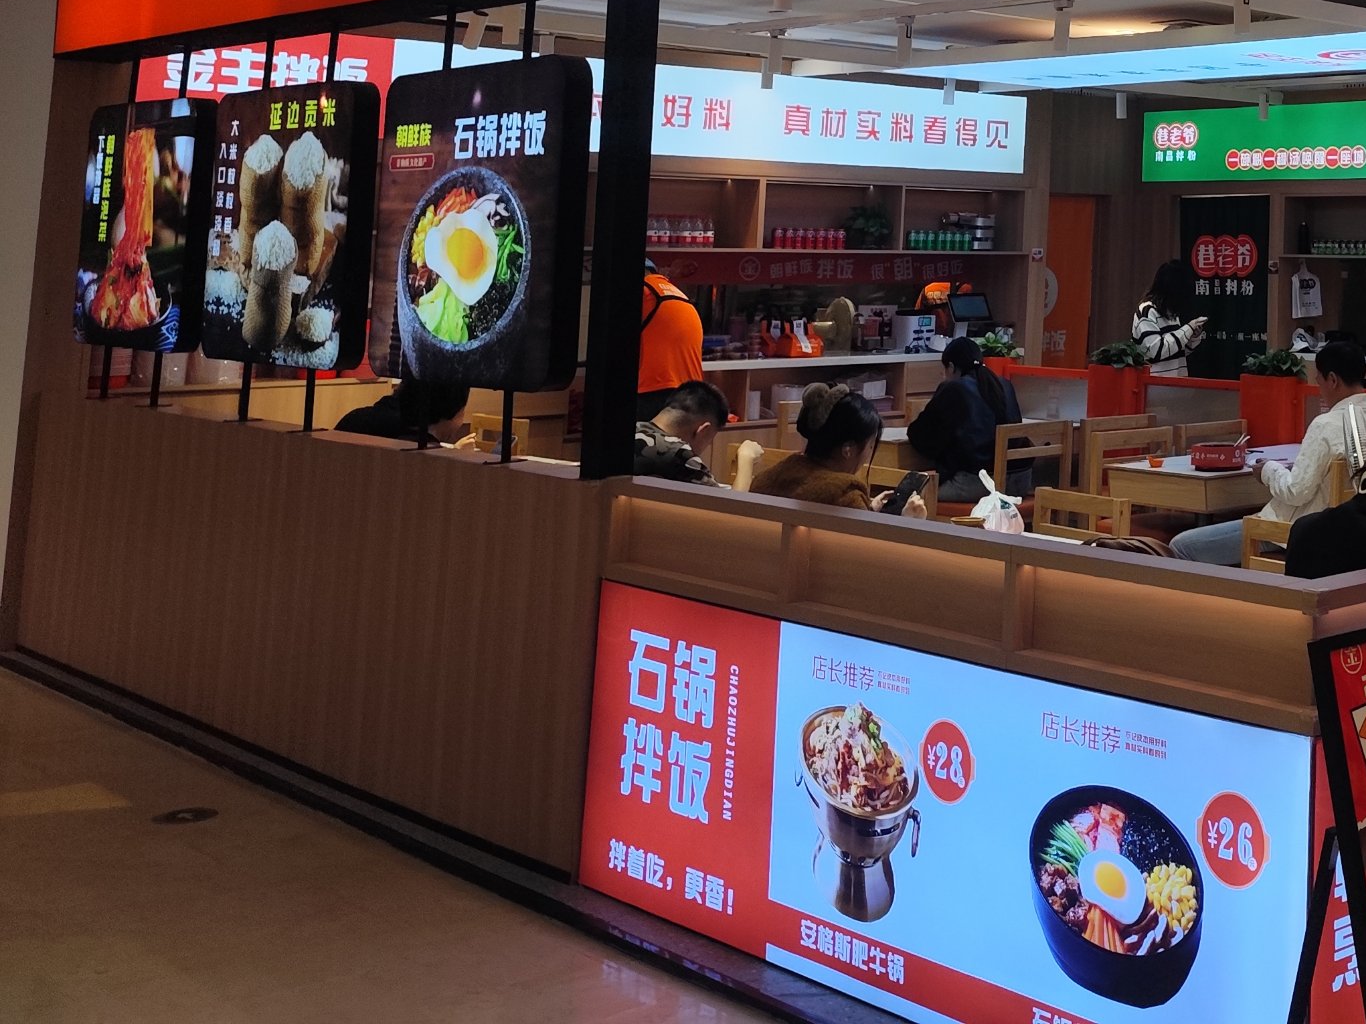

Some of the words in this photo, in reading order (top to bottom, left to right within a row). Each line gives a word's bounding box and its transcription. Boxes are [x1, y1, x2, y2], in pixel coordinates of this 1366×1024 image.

[269, 98, 337, 131] 延边贡米
[395, 122, 433, 149] 朝鲜族
[453, 110, 547, 160] 石锅拌饭
[783, 104, 1010, 150] 真材实料看得见
[1156, 127, 1196, 146] 巷老爷
[627, 628, 718, 729] 石锅
[811, 655, 875, 692] 店长推荐
[722, 664, 740, 821] CHAOZHUJINGDIAN
[1040, 710, 1122, 755] 店长推荐
[619, 717, 712, 825] 拌饭
[800, 919, 905, 985] 安格斯肥牛锅
